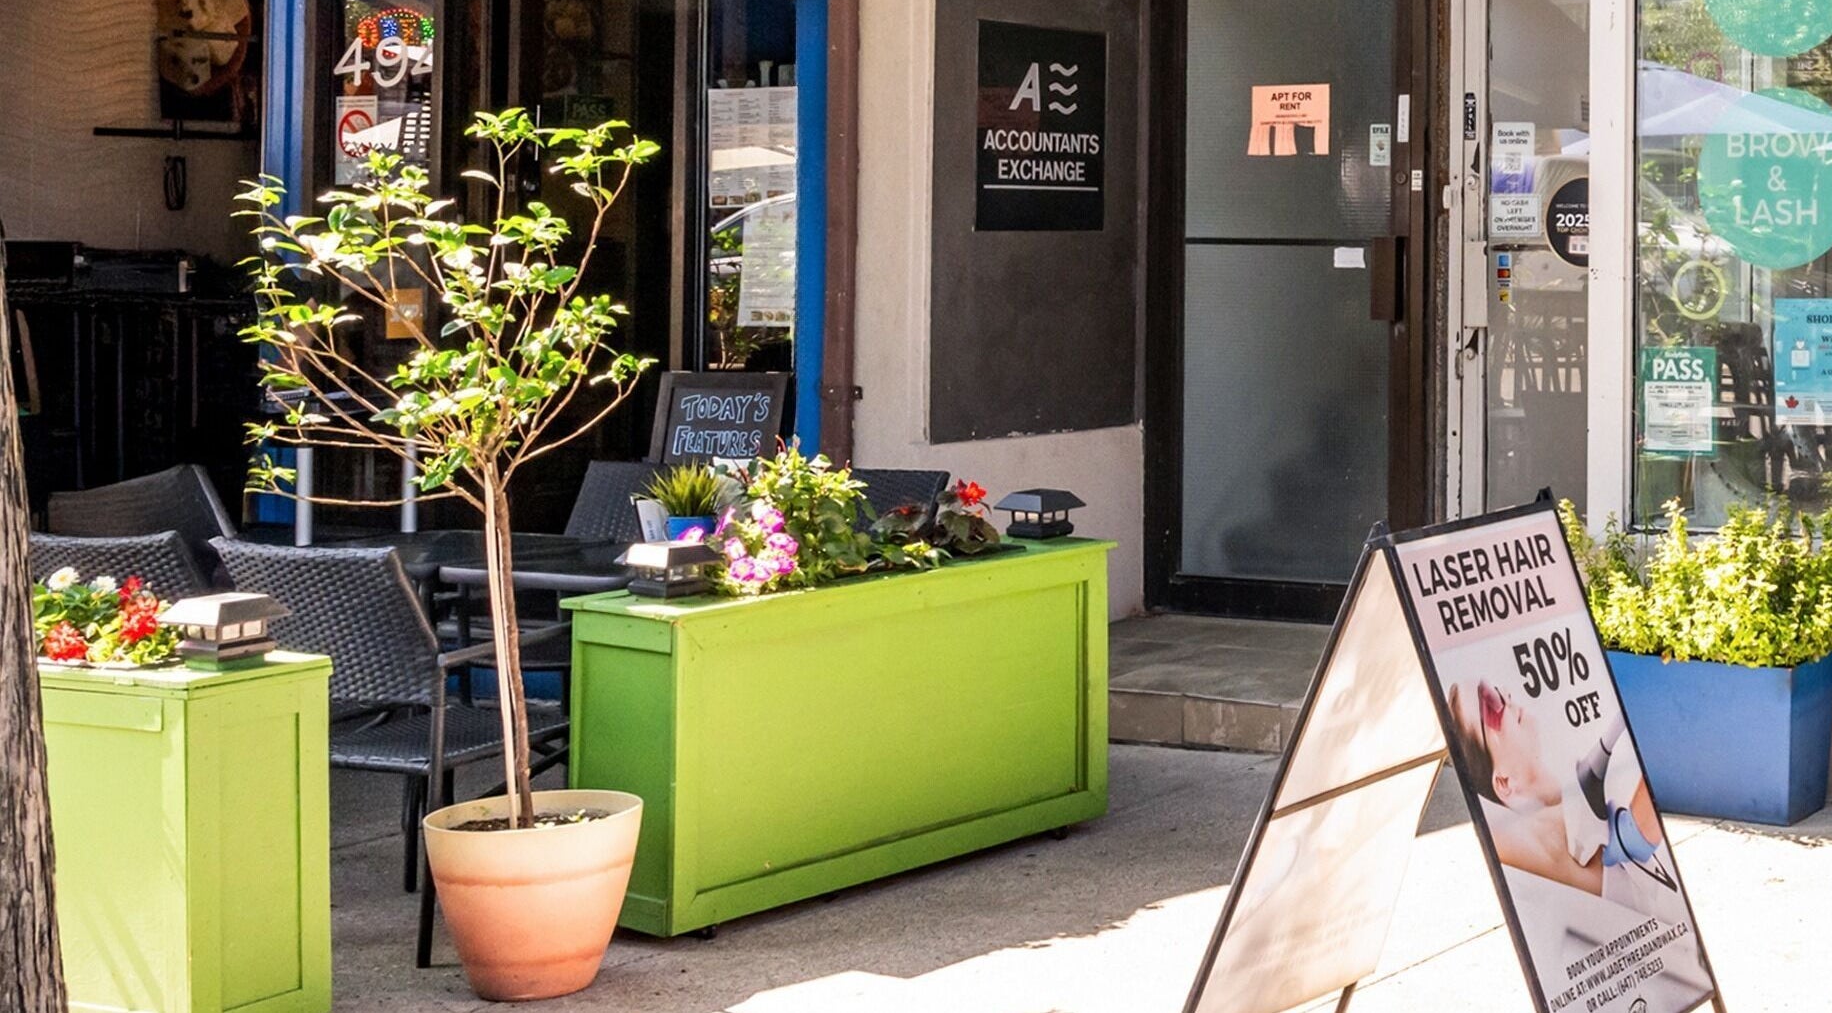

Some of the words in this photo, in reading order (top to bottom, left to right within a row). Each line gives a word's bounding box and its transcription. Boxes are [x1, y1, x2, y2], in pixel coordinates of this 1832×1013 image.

[1270, 92, 1289, 102] APT
[1292, 91, 1312, 101] FOR
[1279, 102, 1301, 111] RENT
[983, 129, 1100, 155] ACCOUNTANTS
[997, 158, 1086, 181] EXCHANGE
[1768, 165, 1787, 192] &
[1735, 198, 1818, 226] LASH
[1652, 358, 1705, 381] PASS
[681, 392, 772, 424] TODAY'S
[672, 425, 762, 457] FEATURES
[1413, 547, 1494, 598] LASER
[1493, 533, 1556, 577] HAIR
[1436, 575, 1556, 636] REMOVAL
[1512, 627, 1590, 699] 50%
[1565, 690, 1601, 728] OFF
[1566, 960, 1588, 980] BOOK
[1584, 947, 1607, 970] YOUR
[1604, 917, 1659, 957] APPOINTMENTS
